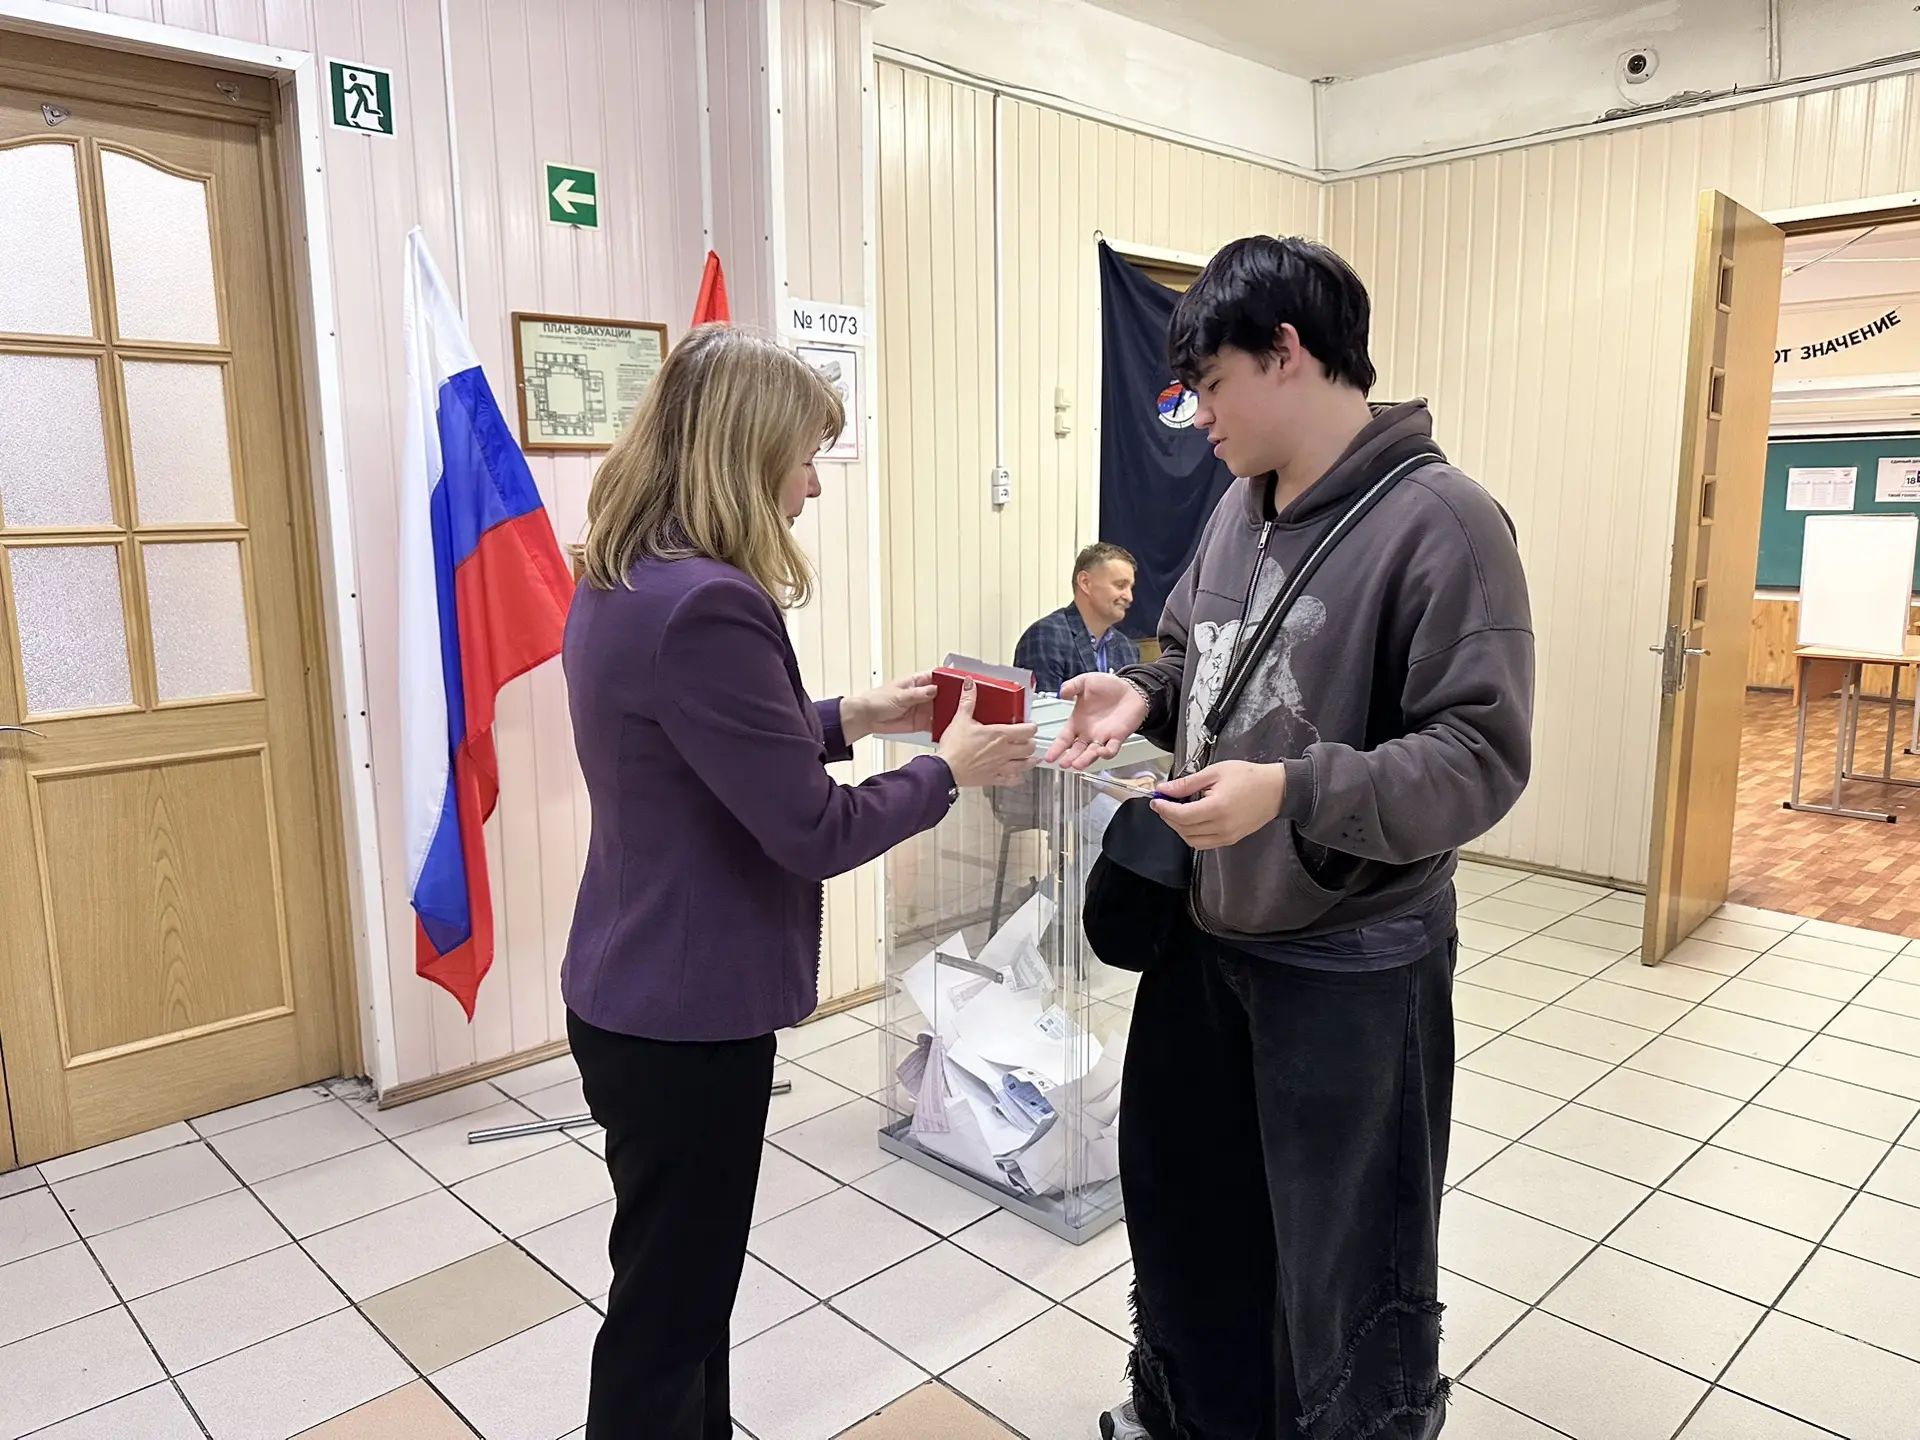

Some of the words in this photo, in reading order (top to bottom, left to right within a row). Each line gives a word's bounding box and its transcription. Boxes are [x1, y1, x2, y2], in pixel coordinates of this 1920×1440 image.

[543, 323, 571, 334] ПЛАН
[574, 324, 631, 338] ЭВАКУАЦИИ
[793, 309, 812, 329] №
[819, 313, 858, 335] 1073
[1800, 310, 1901, 360] ЗНАЧЕНИЕ
[1907, 477, 1916, 485] 18
